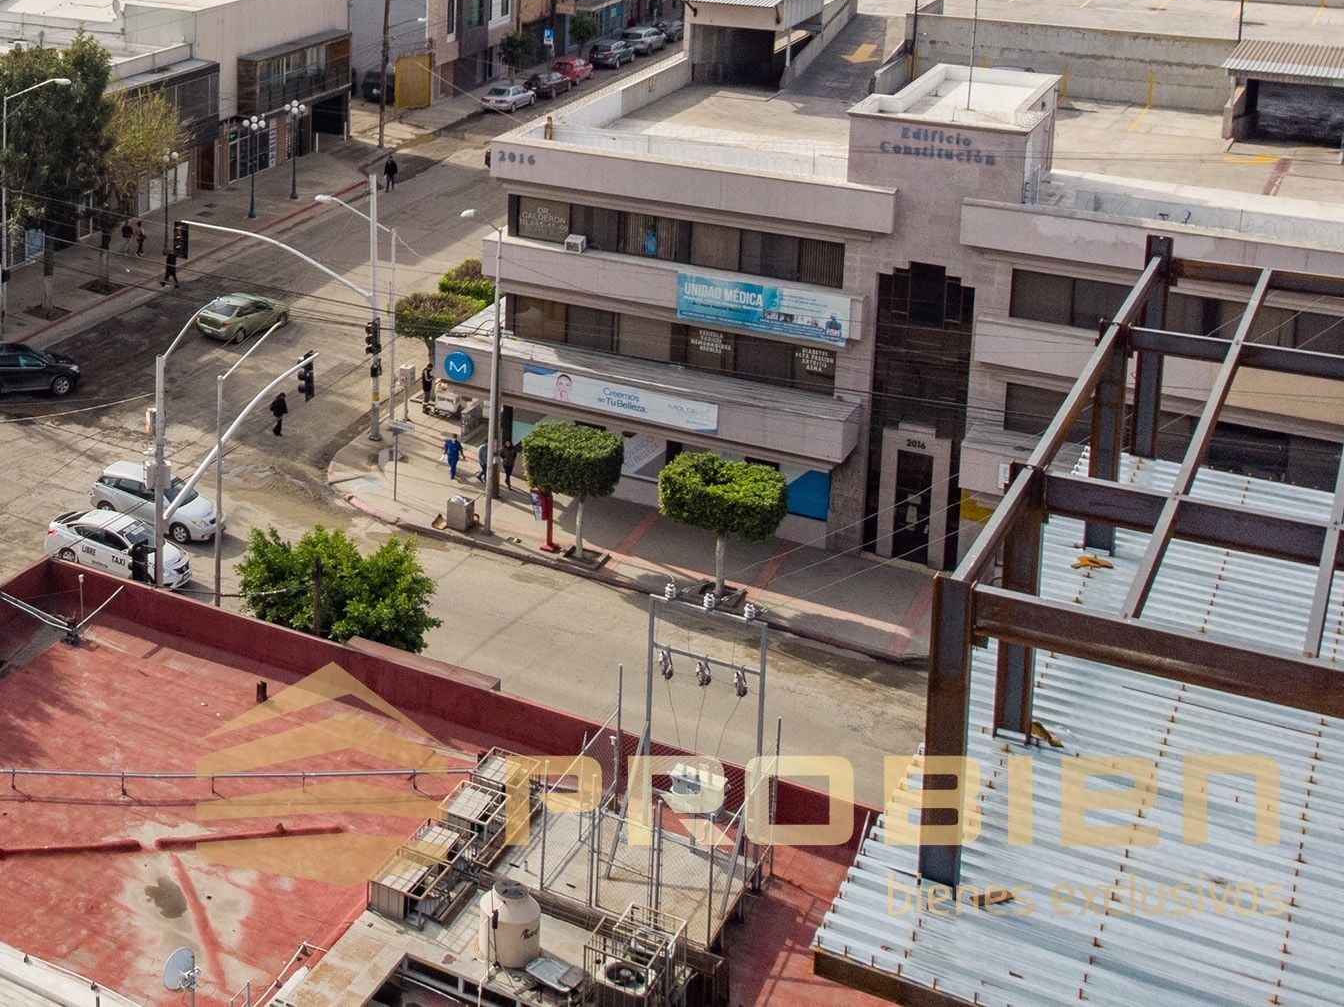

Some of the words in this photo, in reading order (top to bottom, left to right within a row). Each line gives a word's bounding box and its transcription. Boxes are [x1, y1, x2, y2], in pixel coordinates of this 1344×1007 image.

[900, 127, 972, 147] Edificio
[498, 150, 536, 166] 2016
[684, 282, 722, 299] UNIDAD
[724, 286, 764, 308] MÉDICA
[449, 360, 467, 374] M
[602, 386, 640, 403] Creemos
[906, 438, 926, 450] 2016
[82, 545, 97, 557] LIBRE
[111, 554, 126, 567] TAXI
